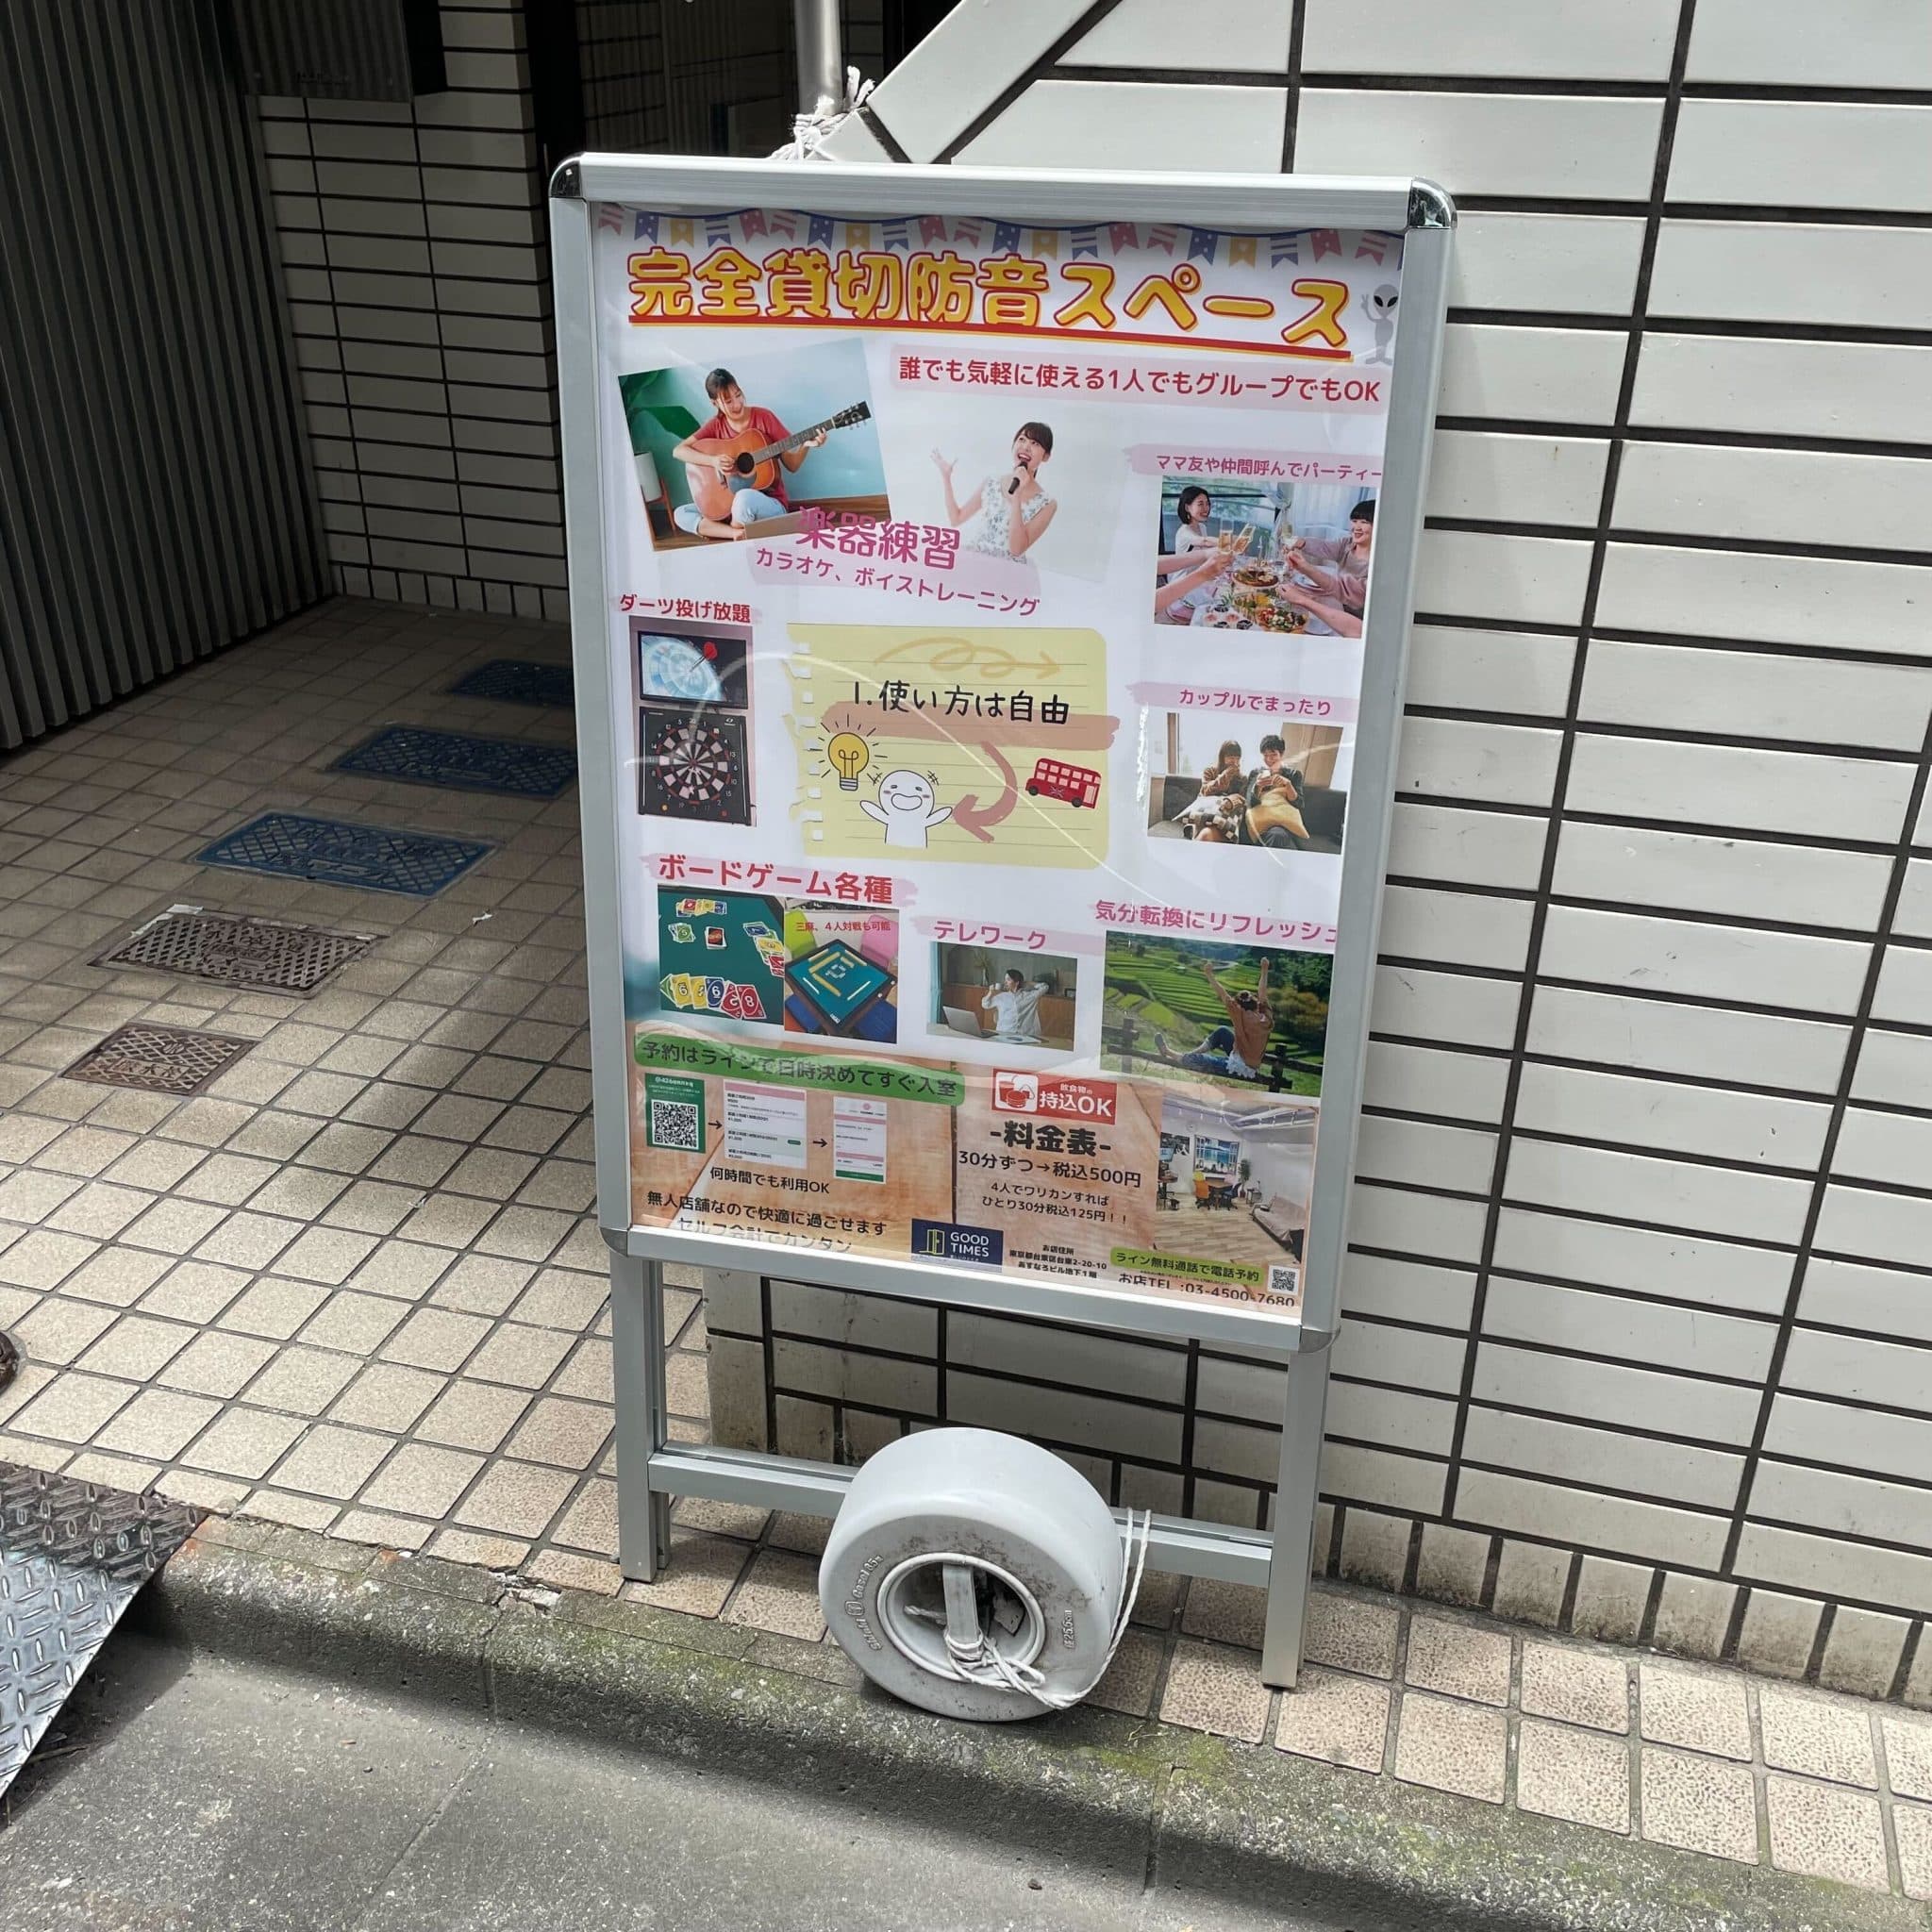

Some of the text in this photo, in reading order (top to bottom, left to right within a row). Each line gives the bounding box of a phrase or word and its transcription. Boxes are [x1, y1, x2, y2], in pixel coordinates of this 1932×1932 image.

[628, 247, 1351, 349] 完全貸切防音スペース
[898, 356, 1380, 403] 誰でも気軽に使える1人でもグループでもOK
[1157, 454, 1382, 482] ママ友や仲間呼んでパーティー
[795, 507, 960, 570] 楽器練習
[619, 592, 751, 624] ダーツ投げ放題
[853, 679, 1071, 725] 1.使い方は自由
[1178, 688, 1332, 717] カップルでまったり
[658, 855, 893, 905] ボードゲーム各種
[935, 922, 1047, 951] テレワーク
[1039, 1091, 1113, 1117] 持込OK
[710, 1166, 830, 1194] 何時間でも利用OK
[991, 1182, 1109, 1206] 4人でワリカンすれば
[646, 1191, 887, 1236] 無人店舗なので快適に過ごせます
[950, 1231, 990, 1245] GOOD
[950, 1242, 990, 1257] TIMES
[1116, 1252, 1259, 1282] ライン無料通話で電話予約
